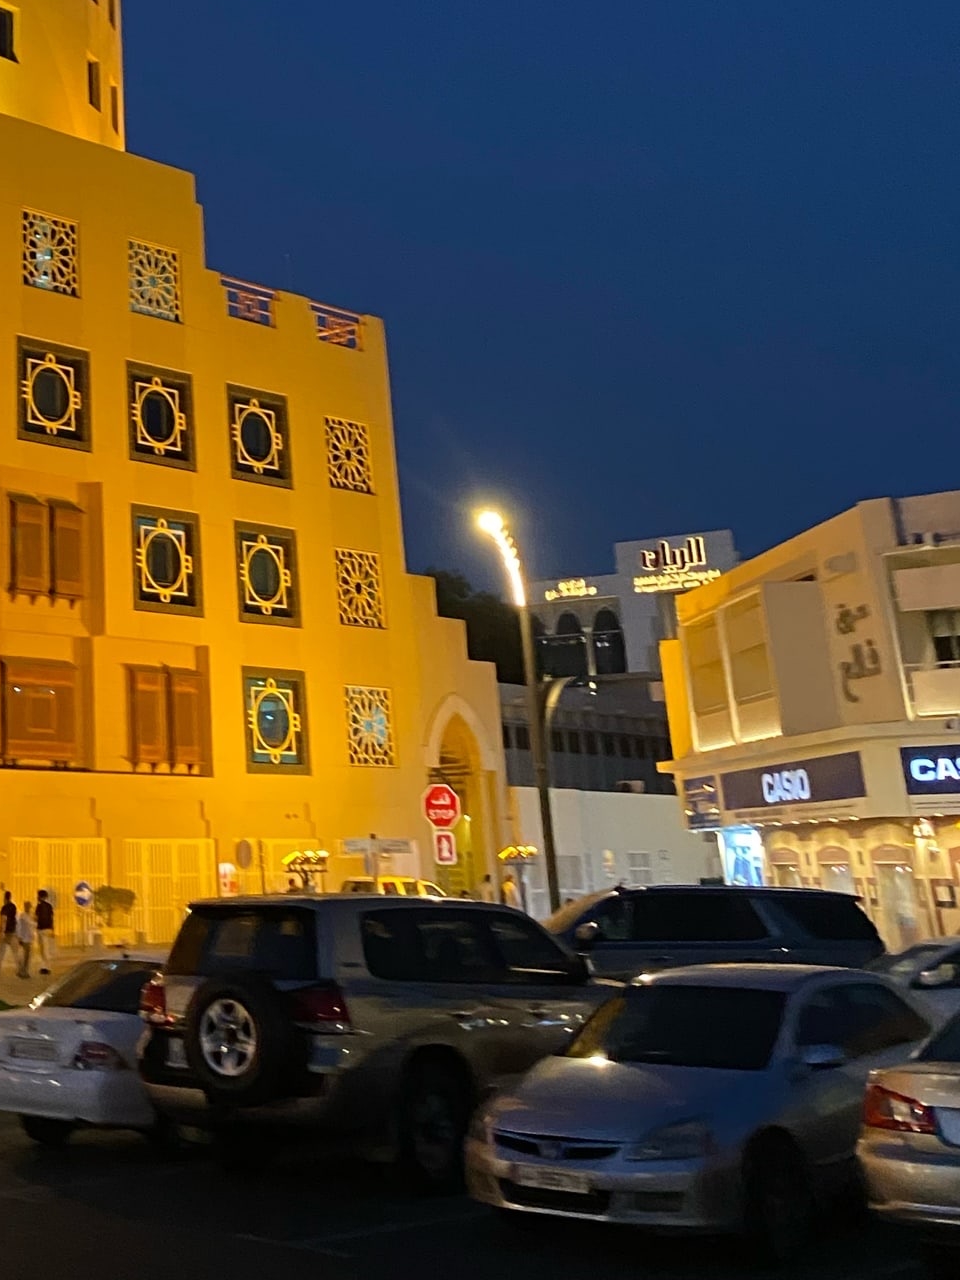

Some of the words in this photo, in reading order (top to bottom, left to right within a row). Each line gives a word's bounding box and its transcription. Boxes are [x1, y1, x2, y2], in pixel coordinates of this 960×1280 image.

[909, 756, 960, 781] CA
[761, 768, 812, 804] CASIO
[428, 808, 456, 820] STOP
